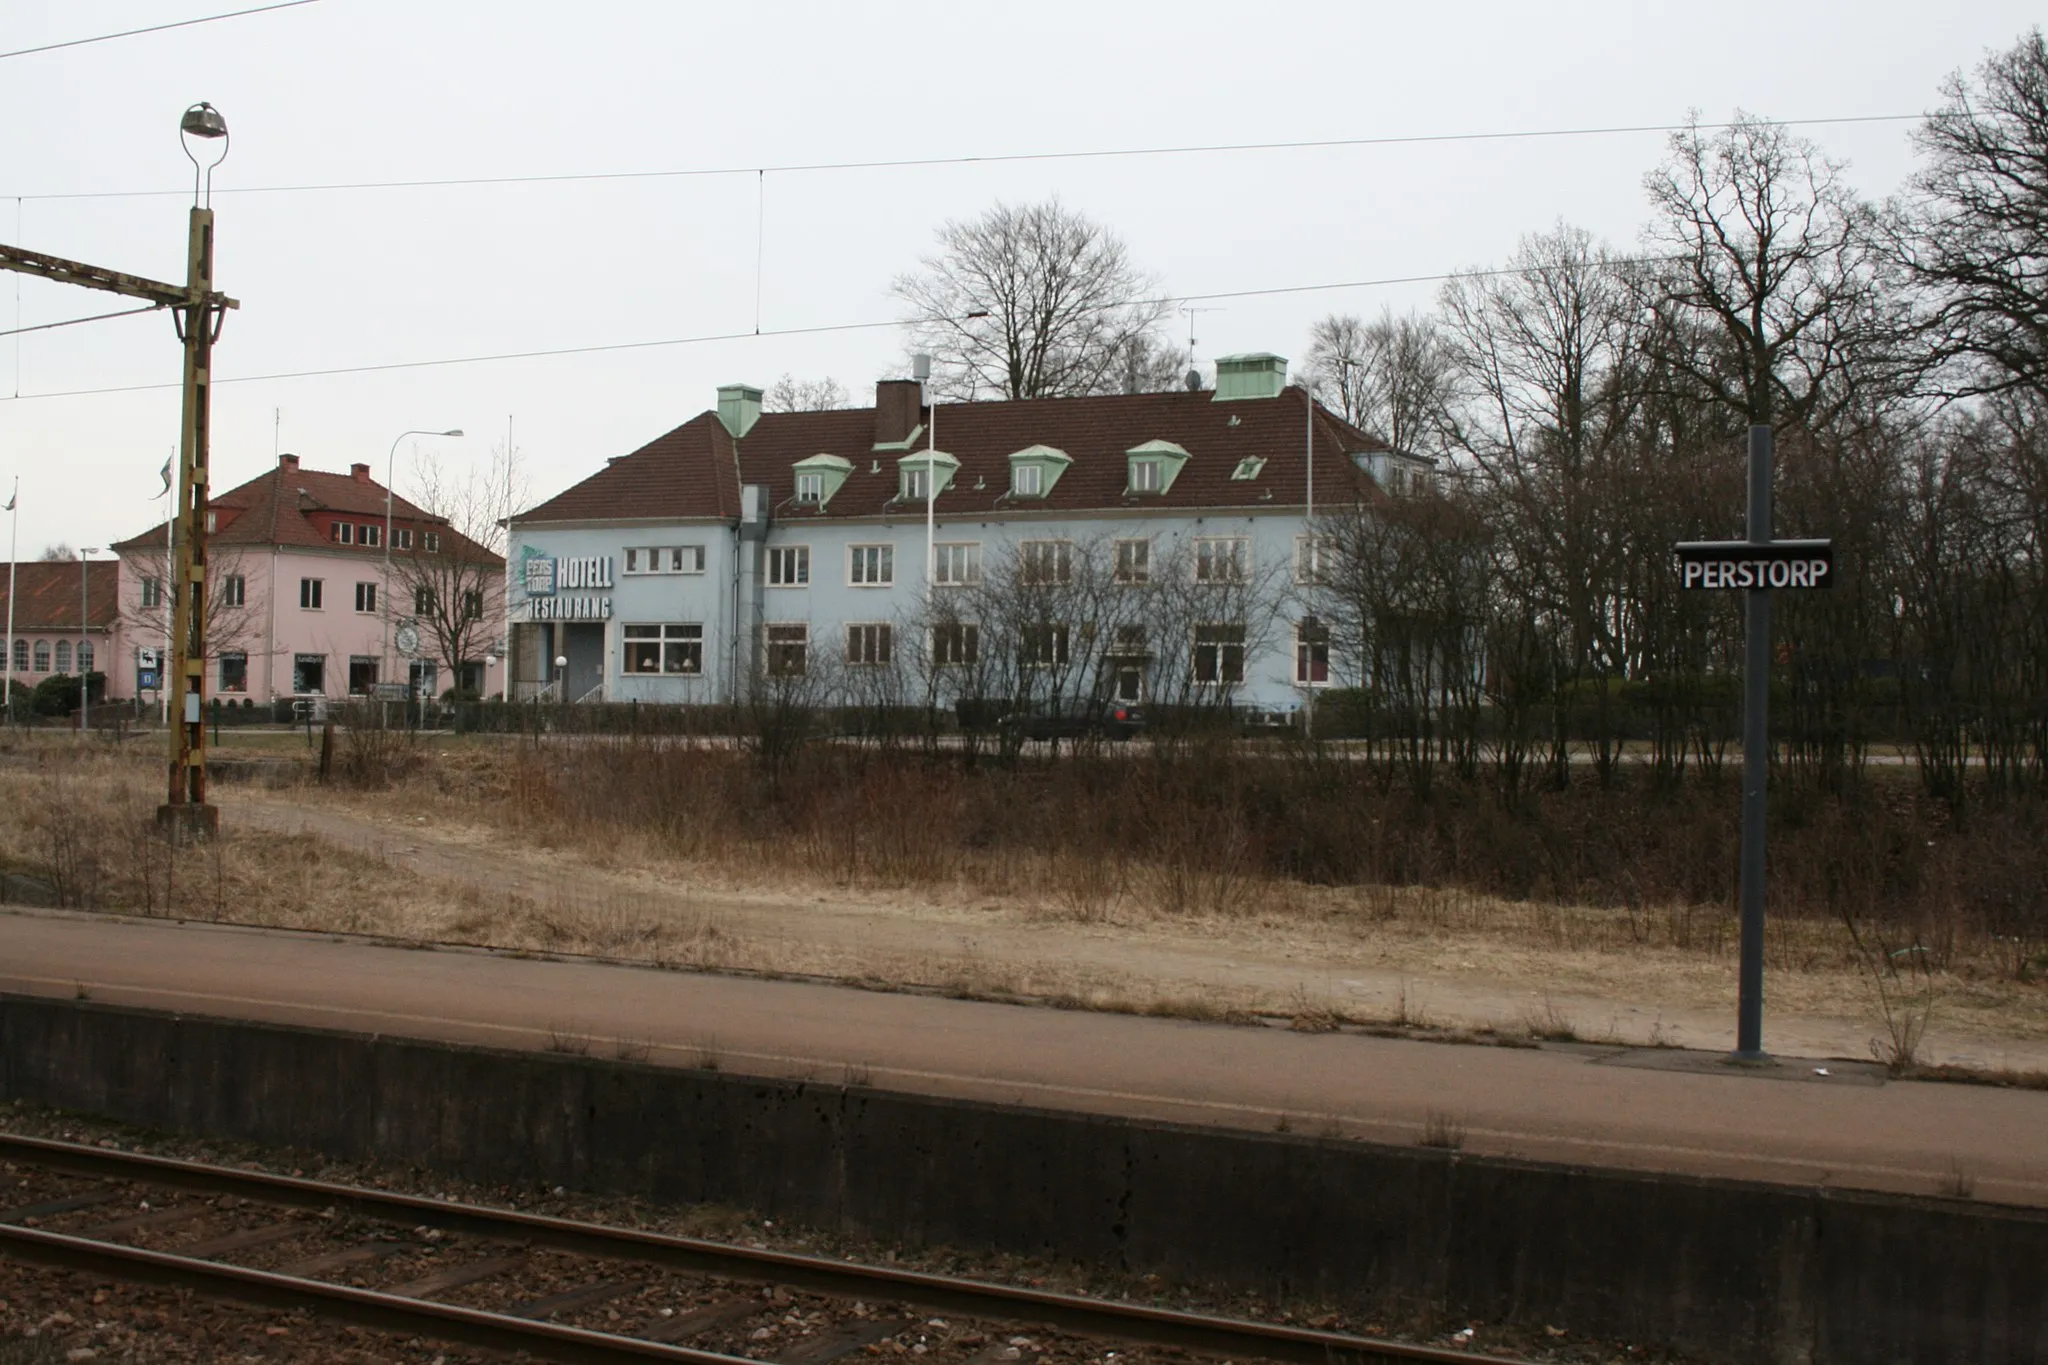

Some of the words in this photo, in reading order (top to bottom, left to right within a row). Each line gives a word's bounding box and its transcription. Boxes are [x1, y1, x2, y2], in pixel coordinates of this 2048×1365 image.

[526, 560, 553, 575] PERS
[557, 556, 613, 588] HOTELL
[1684, 559, 1828, 589] PERSTORP
[527, 576, 553, 592] TORP
[527, 597, 610, 619] RESTAURANG
